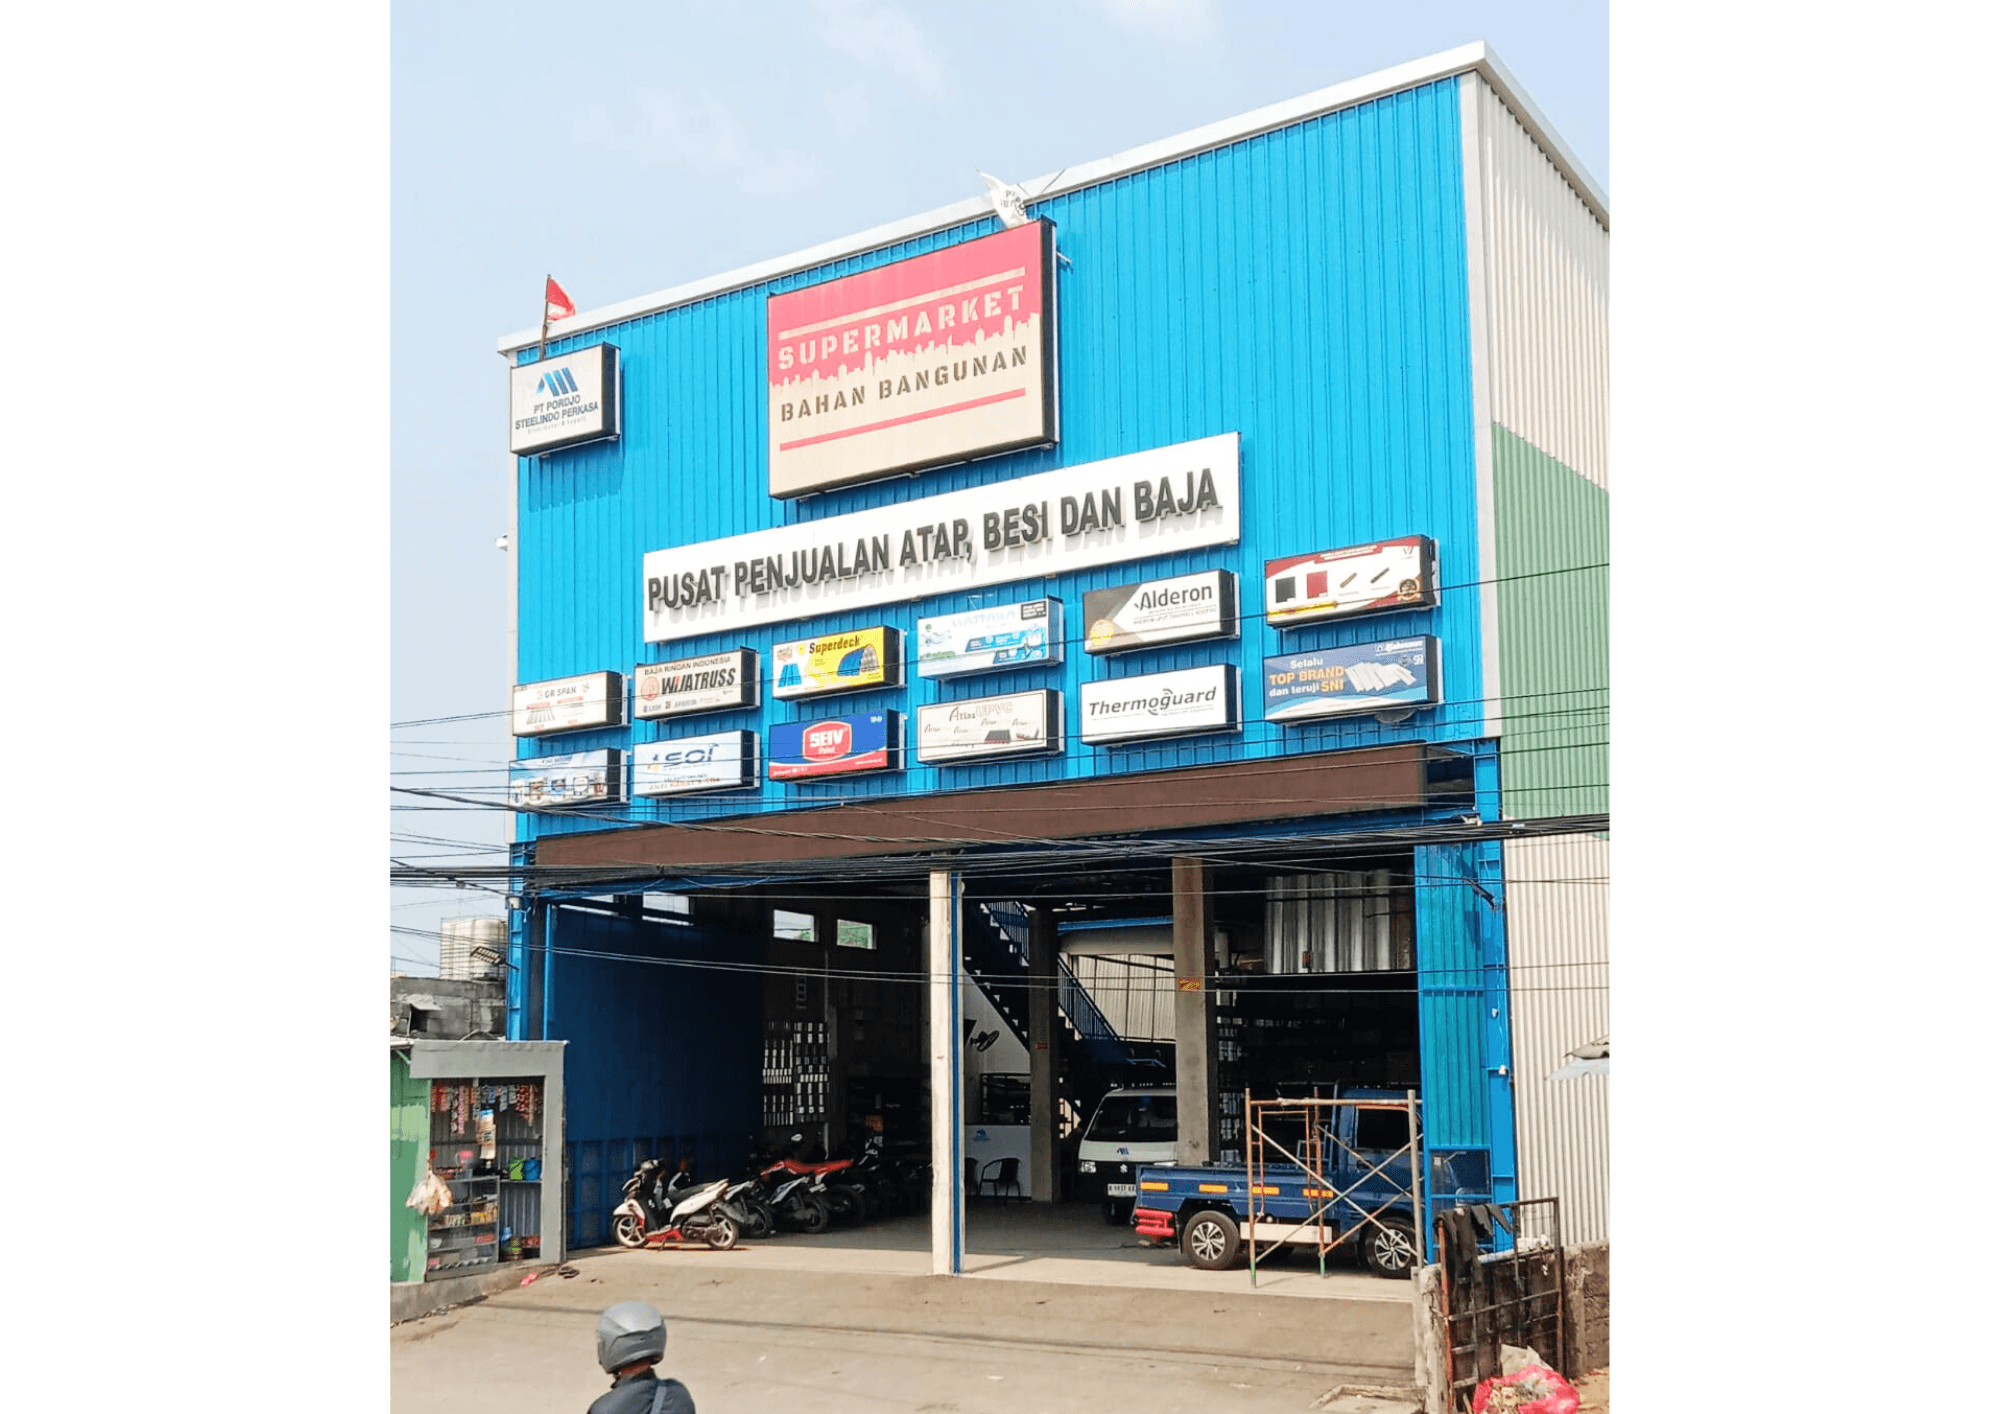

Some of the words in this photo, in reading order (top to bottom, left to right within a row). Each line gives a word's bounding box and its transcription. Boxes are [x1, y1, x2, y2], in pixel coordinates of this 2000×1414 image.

[778, 284, 1024, 370] SUPERMARKET
[781, 385, 865, 422] BAHAN
[879, 345, 1027, 399] BANGUNAN
[534, 402, 545, 414] PT
[546, 395, 581, 411] PORDJO
[515, 411, 559, 430] STEELINDO
[561, 401, 598, 419] PERKASA
[648, 565, 725, 611] PUSAT
[734, 533, 889, 596] PENJUALAN
[899, 518, 973, 566] ATAP,
[983, 500, 1048, 550] BESI
[1060, 486, 1121, 535] DAN
[1134, 467, 1219, 521] BAJA
[1133, 585, 1213, 611] Alderon
[809, 635, 860, 655] Superdeck
[692, 656, 731, 668] INDONESIA
[1290, 657, 1324, 670] Selalu
[1269, 672, 1296, 686] TOP
[1298, 665, 1346, 681] BRAND
[1269, 685, 1289, 697] dan
[1290, 681, 1320, 696] teruji
[1321, 680, 1345, 692] SNI
[1089, 686, 1217, 716] Thermoguard
[810, 728, 844, 748] SEIV
